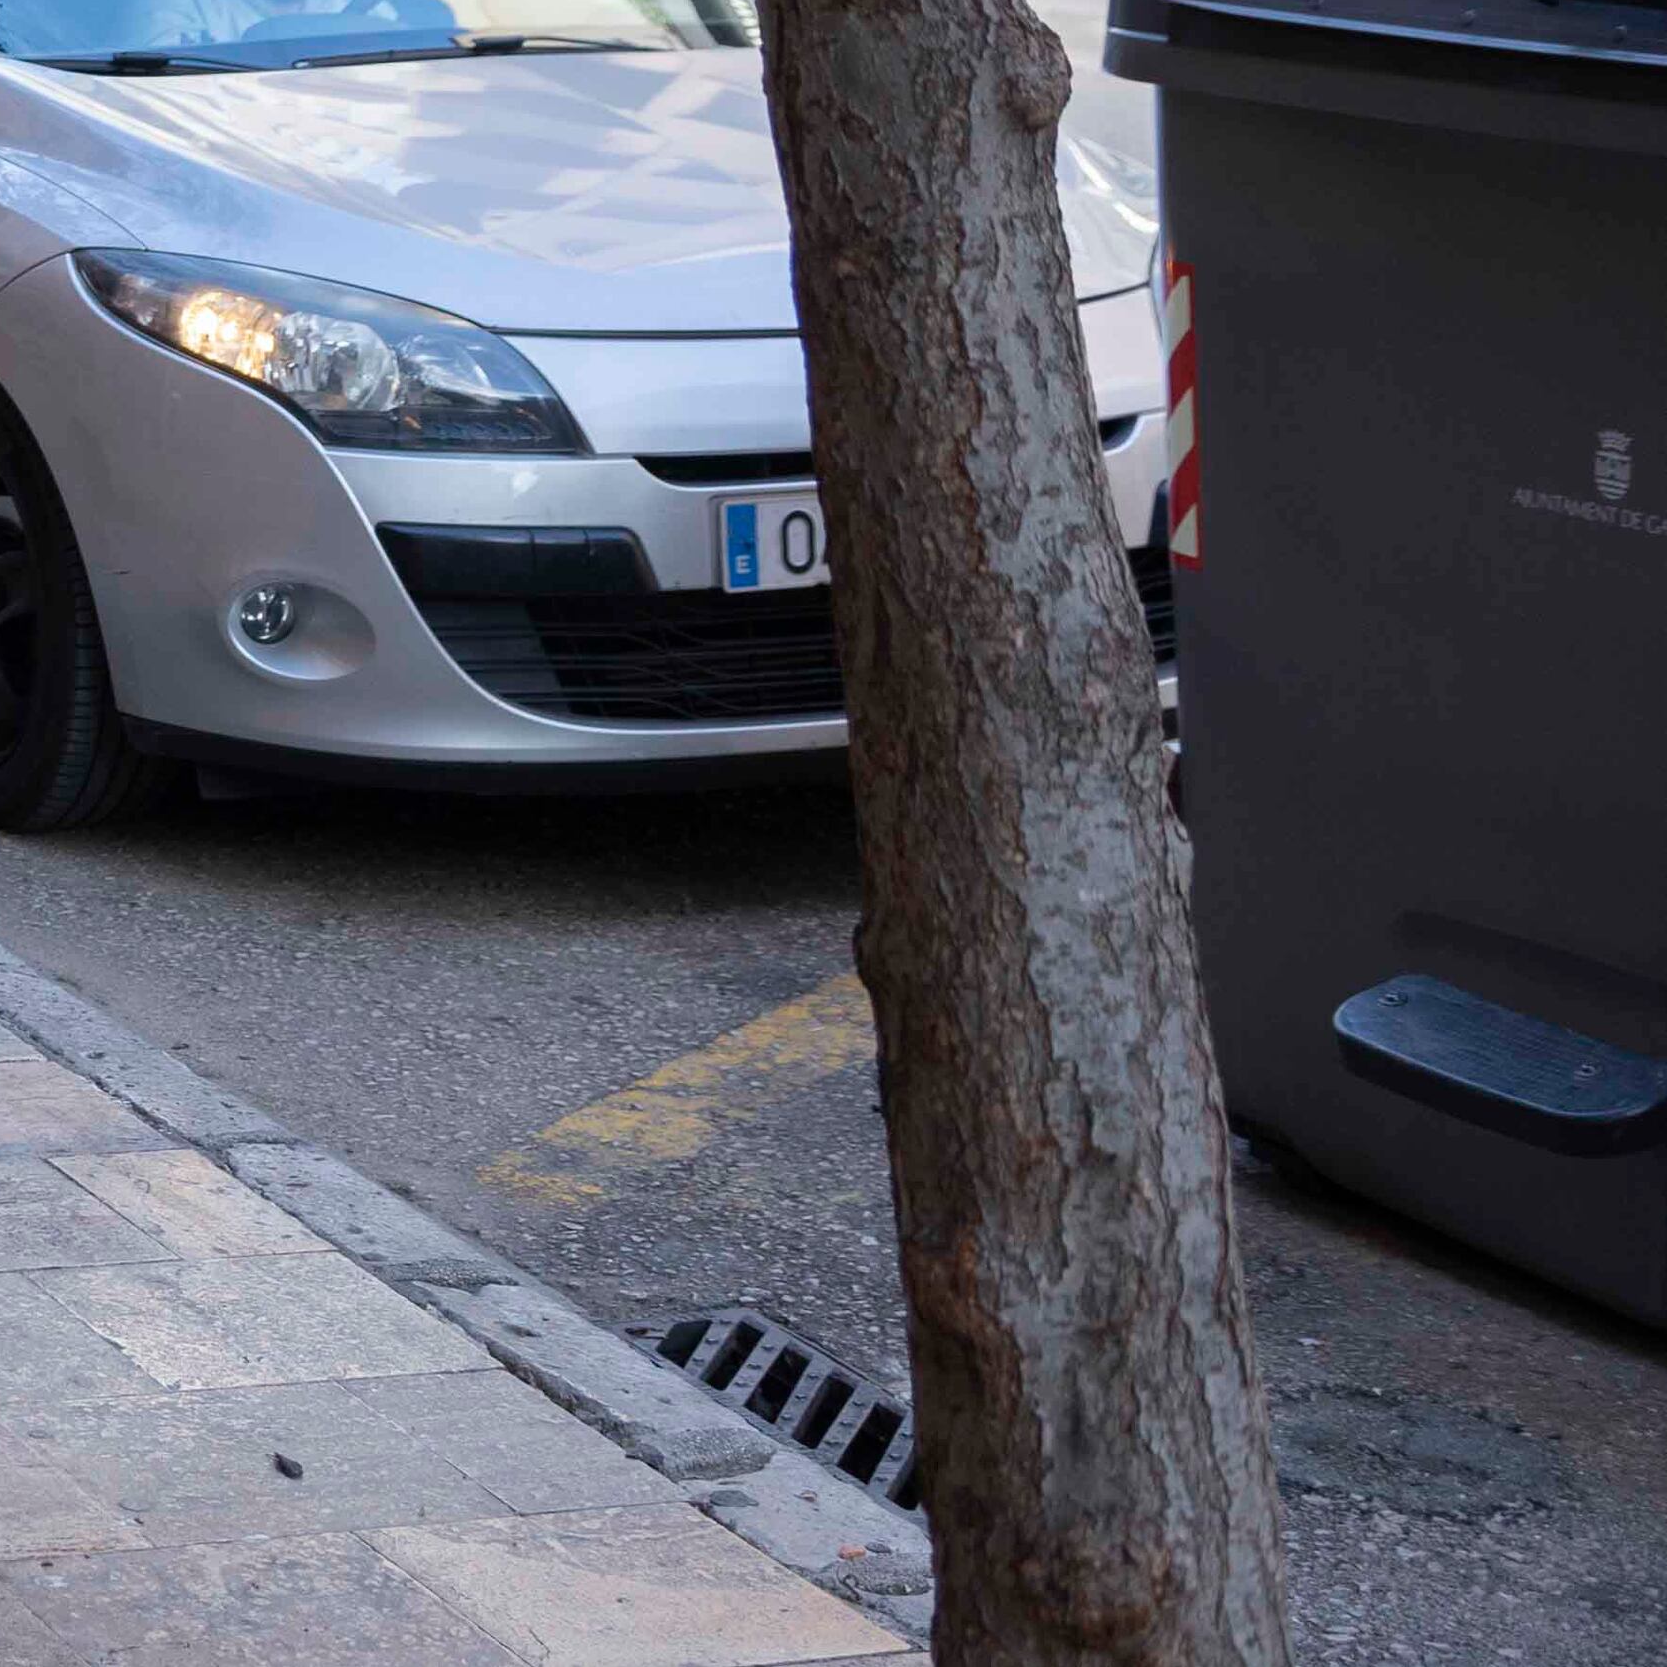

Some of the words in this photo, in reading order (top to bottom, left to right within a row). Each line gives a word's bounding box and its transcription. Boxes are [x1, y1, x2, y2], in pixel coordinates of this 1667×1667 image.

[1620, 510, 1644, 531] DE
[781, 510, 828, 574] 0
[735, 554, 752, 575] E
